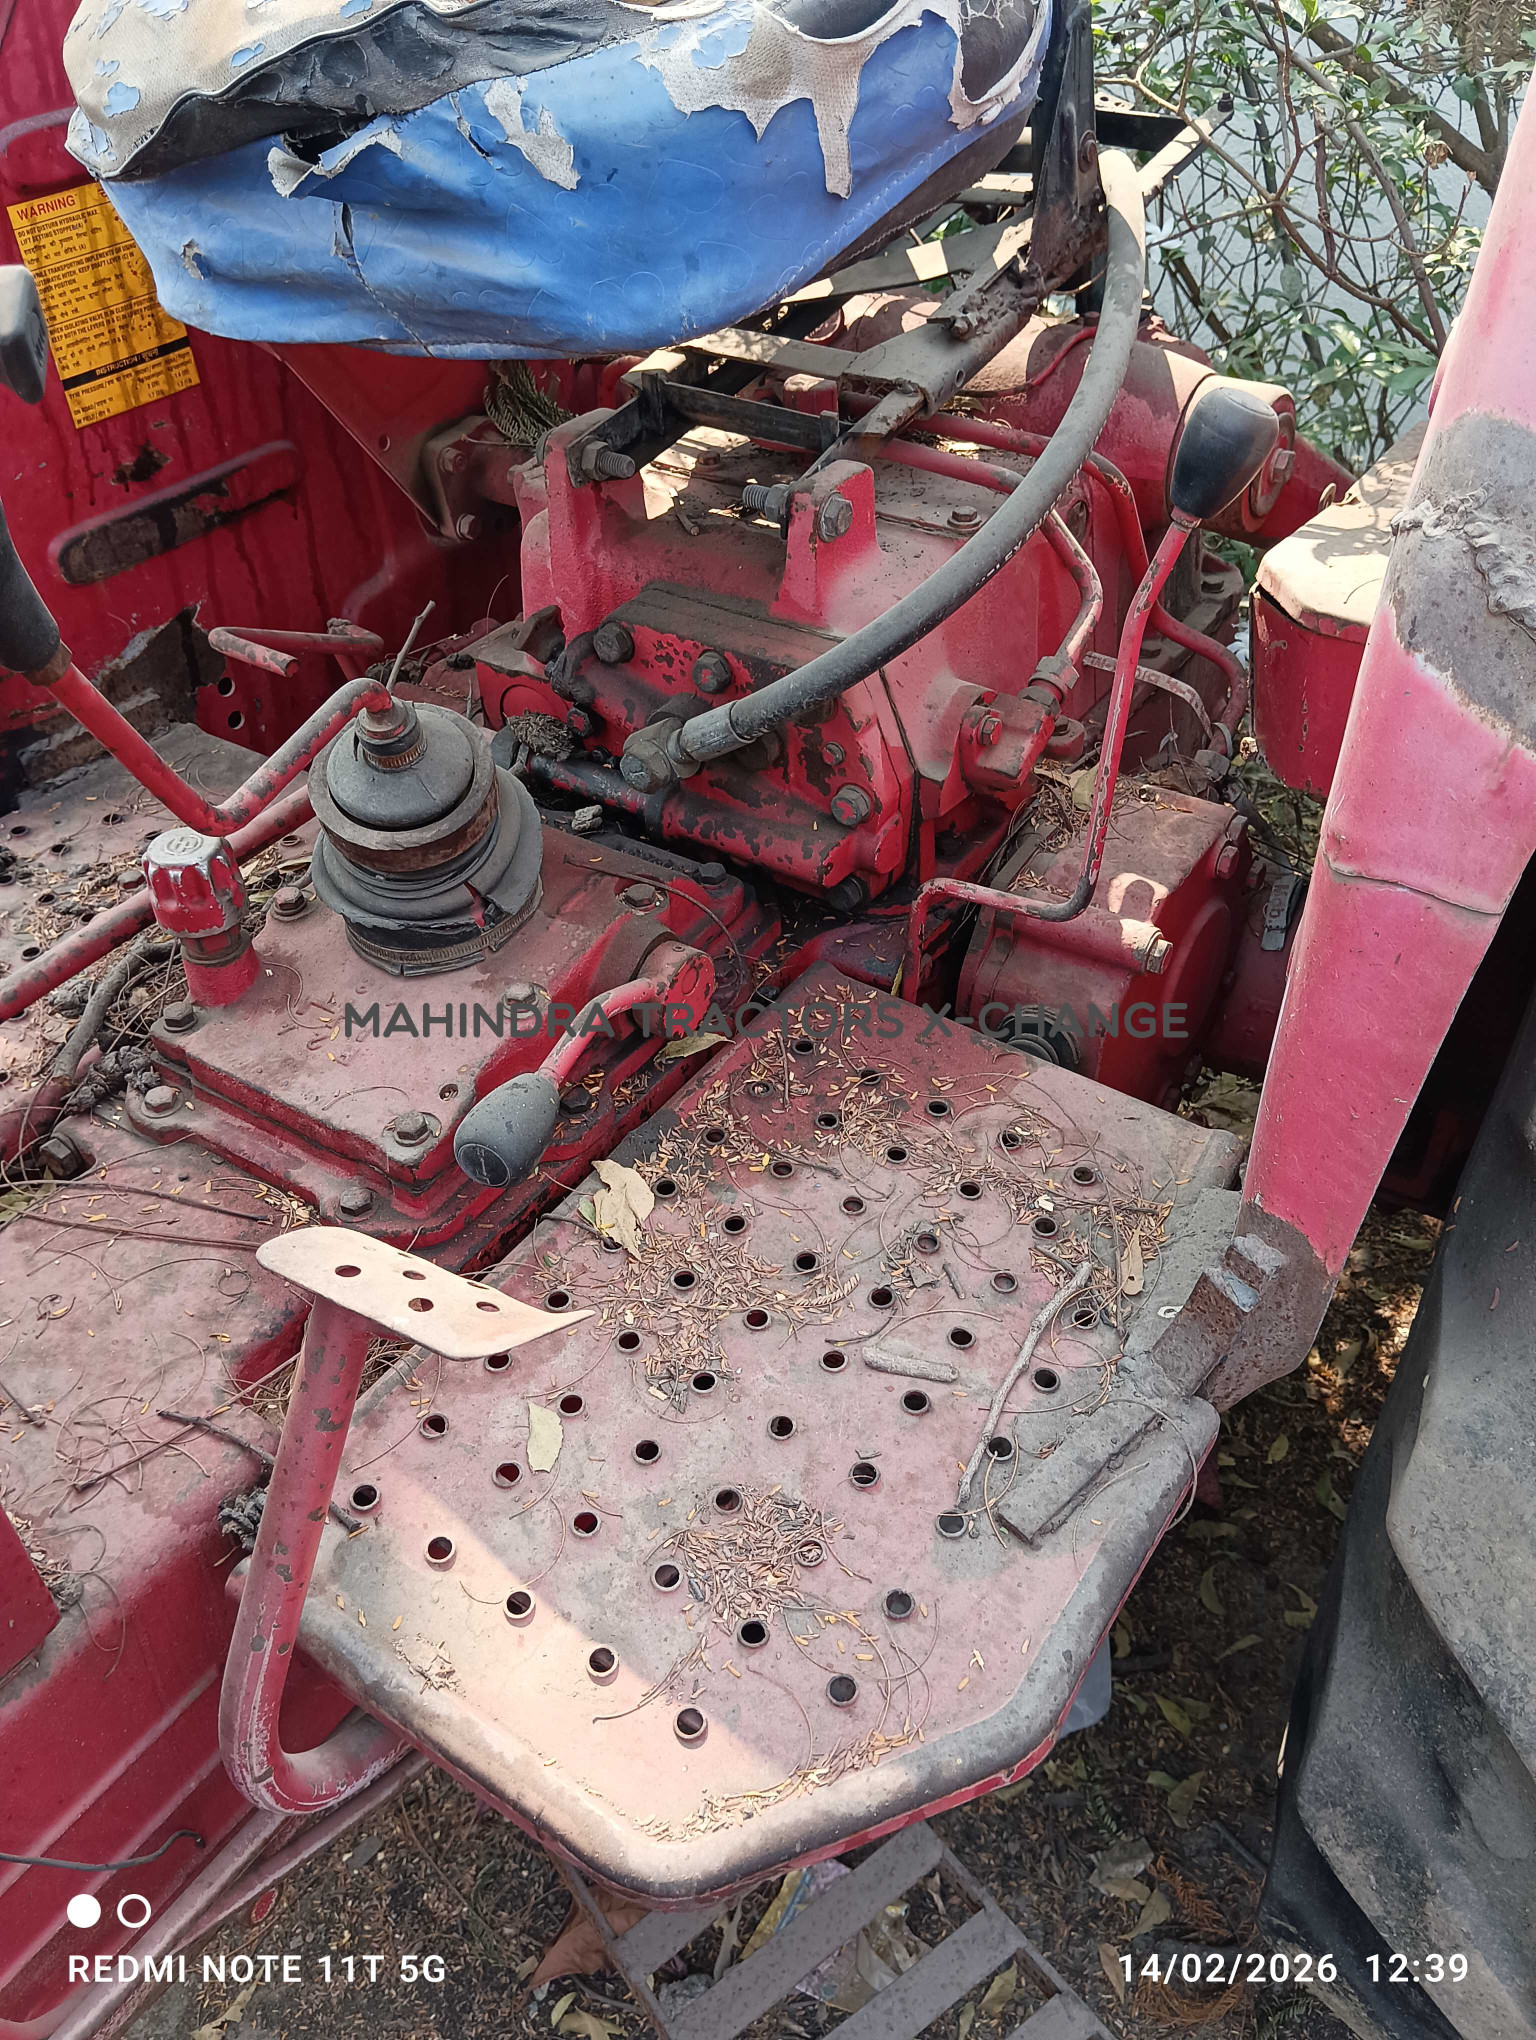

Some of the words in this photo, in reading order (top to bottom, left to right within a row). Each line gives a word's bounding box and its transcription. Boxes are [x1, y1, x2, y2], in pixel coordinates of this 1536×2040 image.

[17, 195, 75, 220] WARNING
[37, 221, 57, 230] DISTURB
[59, 213, 85, 224] HYDRAULIC
[32, 232, 52, 241] SETTING
[48, 259, 83, 273] TRANSPORTING
[85, 250, 114, 262] IMPLEMENTS
[91, 261, 105, 269] DRAFT
[107, 256, 120, 264] LEVER
[49, 326, 63, 334] WHEN
[64, 319, 88, 329] ISOLATING
[89, 313, 103, 321] VALVE
[64, 330, 76, 338] BOTH
[87, 321, 104, 330] LEVERS
[94, 356, 138, 375] INSTRUCTION
[68, 390, 80, 399] TYRE
